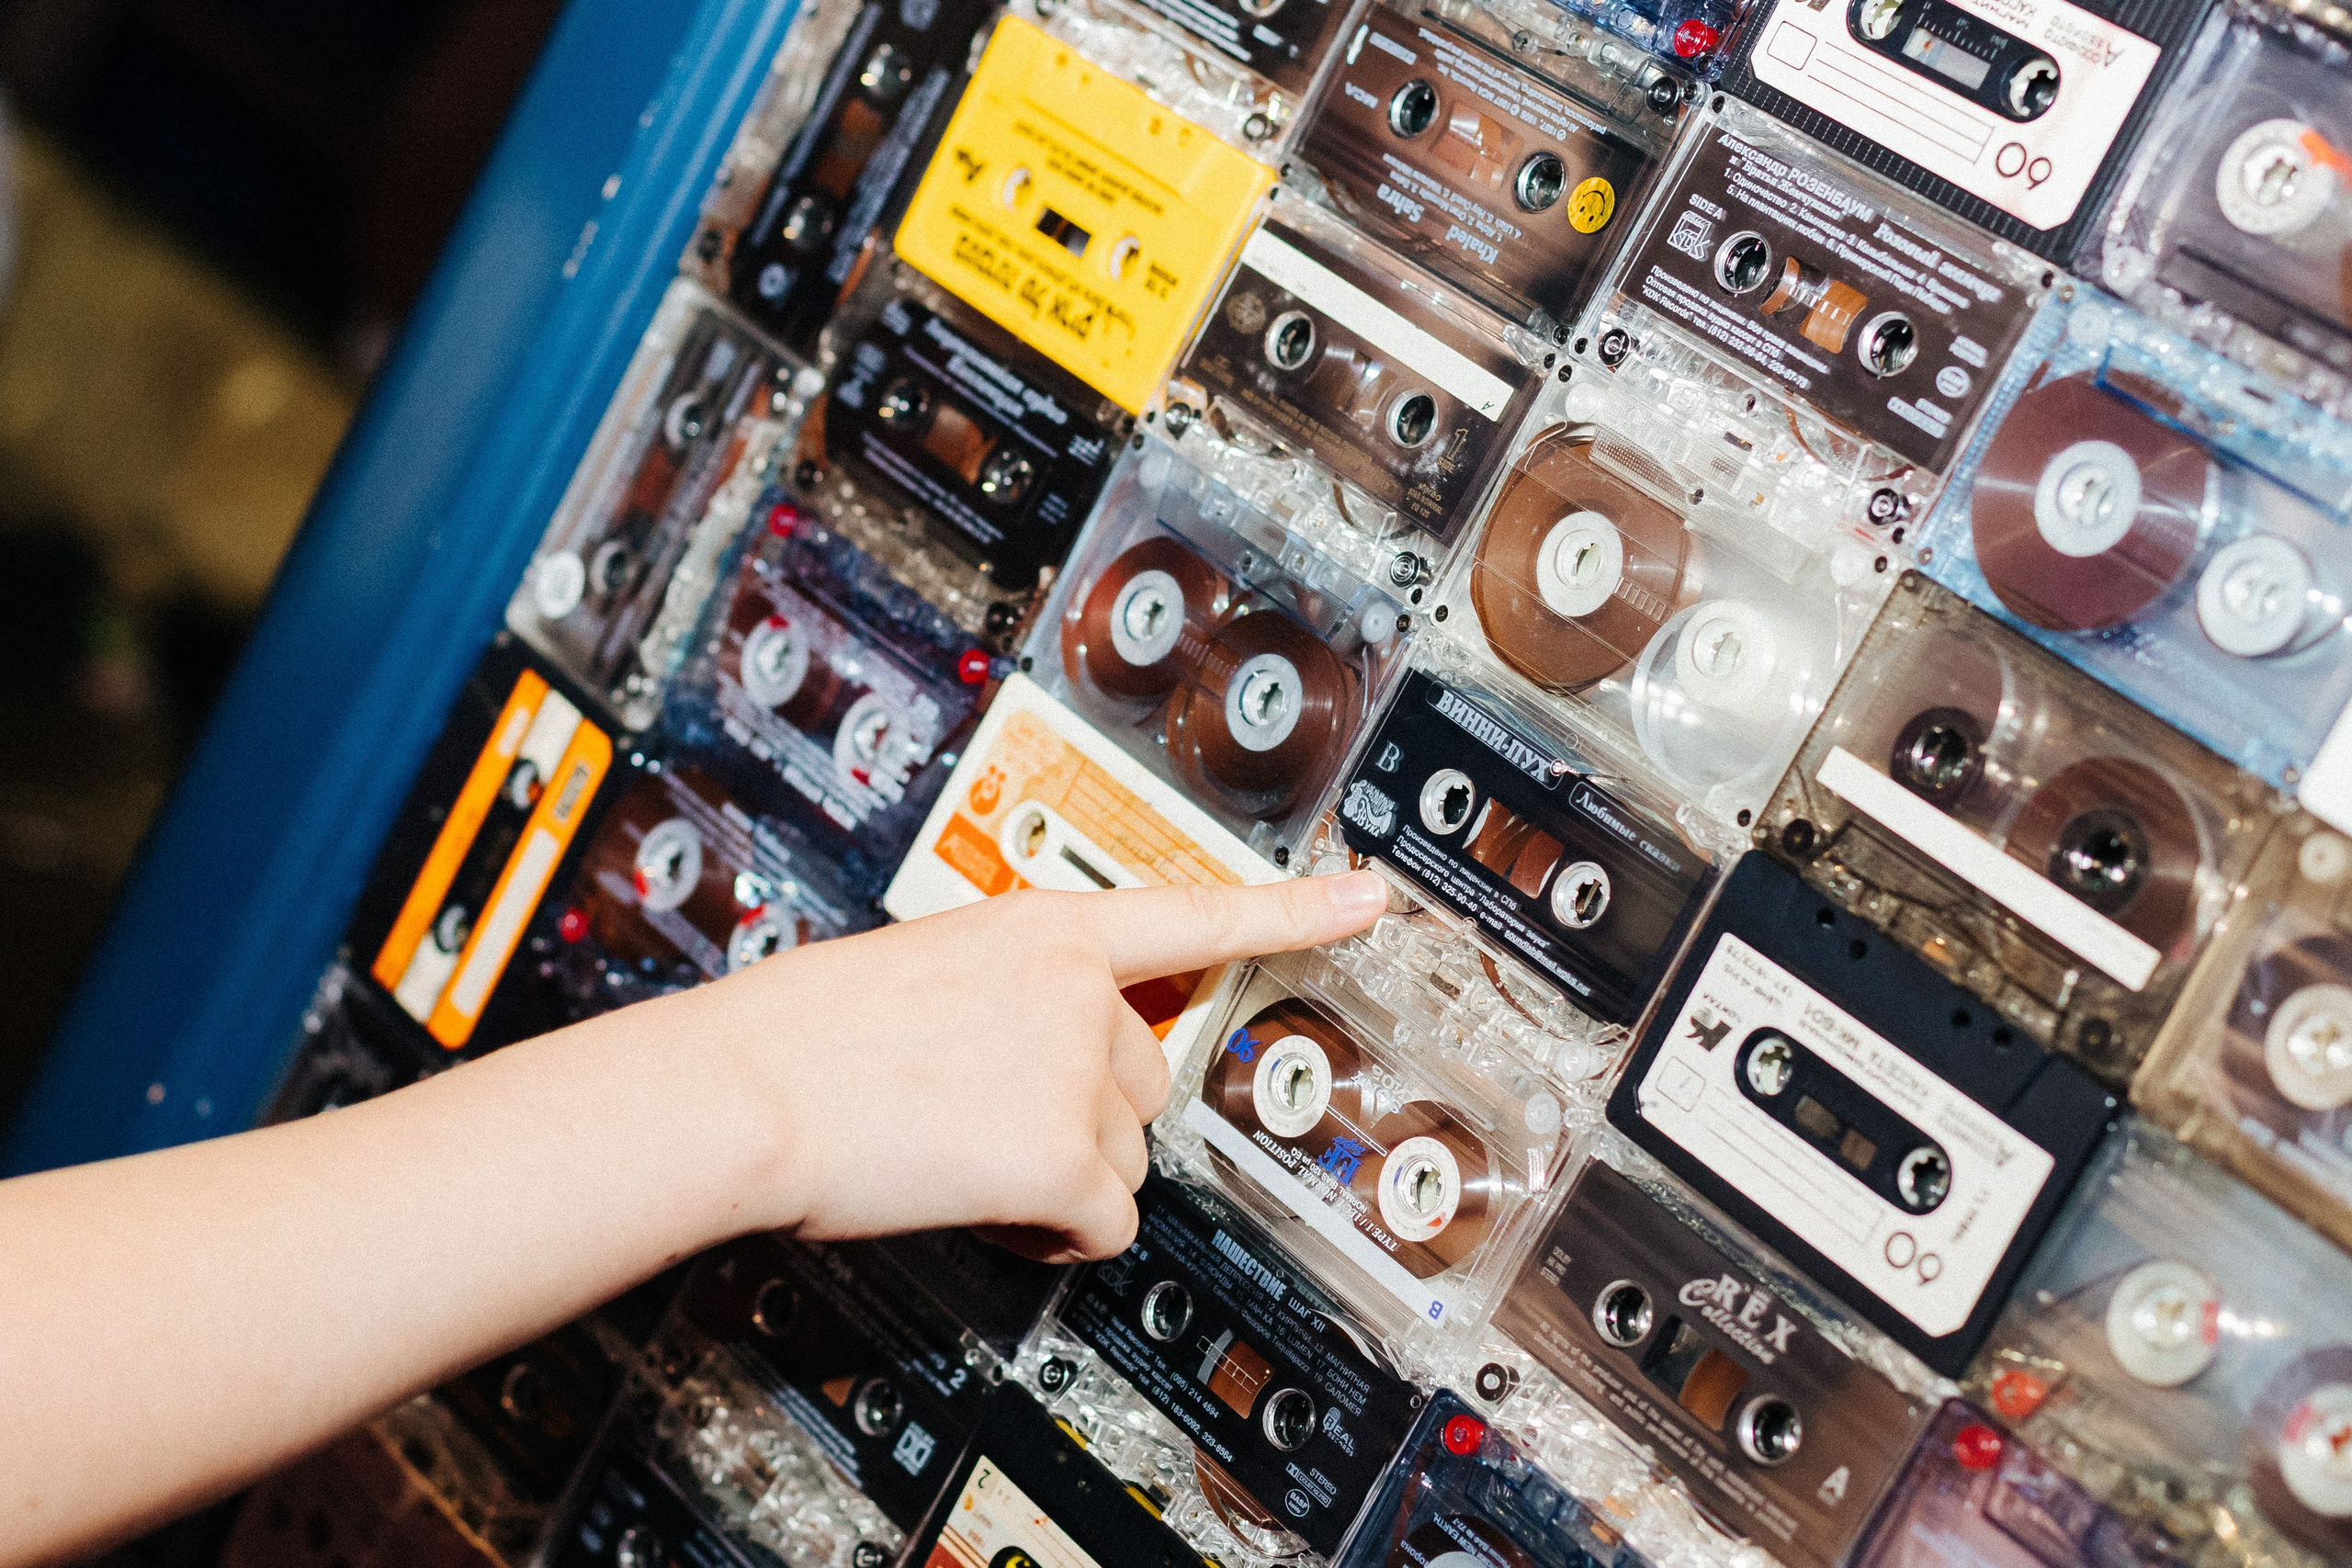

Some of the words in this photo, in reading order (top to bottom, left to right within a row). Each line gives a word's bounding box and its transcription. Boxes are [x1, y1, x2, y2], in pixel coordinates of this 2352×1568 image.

[1715, 130, 1790, 180] Александр
[1785, 164, 1874, 224] РОЗЕНБАУМ
[1993, 139, 2052, 192] 60
[1371, 181, 1427, 225] Sahra
[1687, 191, 1716, 215] SIDE
[1711, 205, 1725, 220] A
[1730, 170, 1789, 210] Одиночество
[1796, 206, 1848, 242] Камикадзе
[1735, 187, 1751, 203] На
[1746, 194, 1799, 231] плантациях
[1794, 220, 1827, 245] любви
[1443, 223, 1500, 266] Khaled
[1644, 273, 1678, 299] Оптовая
[1648, 264, 1701, 300] Произведено
[1441, 423, 1470, 462] 1
[1434, 455, 1457, 474] SIDE
[1415, 480, 1443, 502] stereo
[1431, 688, 1555, 784] ВИННИ-ПУХ
[1574, 788, 1642, 843] Любимые
[1388, 844, 1423, 873] Телефон
[1419, 867, 1442, 887] (812)
[1439, 881, 1479, 913] 325-90-40
[1393, 834, 1452, 879] Продюсерского
[1448, 874, 1476, 897] центра
[1400, 823, 1450, 862] Произведено
[1446, 856, 1460, 869] по
[1457, 864, 1494, 894] лицензии
[1498, 893, 1519, 911] СПб
[1224, 1026, 1260, 1063] 90
[1250, 1128, 1297, 1169] POSITION
[1288, 1145, 1304, 1160] EQ
[1329, 1126, 1367, 1161] Super
[1307, 1161, 1324, 1177] 120
[1312, 1136, 1367, 1189] EF
[1318, 1170, 1340, 1190] BIAS
[1294, 1163, 1339, 1202] NORMAL
[1337, 1186, 1369, 1214] NORMAL
[1340, 1201, 1363, 1223] IEC
[1370, 1225, 1399, 1252] TYPE
[1884, 1231, 1944, 1285] 60
[1207, 1228, 1289, 1302] НАШЕСТВИЕ
[1285, 1296, 1312, 1321] ШАГ
[1309, 1315, 1328, 1334] XII
[1423, 1298, 1446, 1321] B
[1275, 1309, 1313, 1344] КИРПИЧИ
[1323, 1351, 1371, 1393] МАГНИТНАЯ
[1284, 1333, 1314, 1359] LUMEN
[1324, 1368, 1350, 1391] БОНИ
[1346, 1386, 1367, 1406] НЕМ
[944, 1365, 972, 1393] 2
[1148, 1369, 1174, 1393] кассет
[1168, 1371, 1190, 1392] (095)
[1186, 1388, 1203, 1404] 214
[1200, 1400, 1220, 1419] 4594
[1107, 1344, 1139, 1374] Records"
[1148, 1384, 1171, 1405] (812)
[1199, 1430, 1235, 1463] 323-8564
[1322, 1381, 1363, 1417] САЛОМЕЯ
[972, 1467, 994, 1490] 2
[1306, 1466, 1339, 1496] STEREO
[1821, 1461, 1858, 1499] A
[1287, 1490, 1309, 1511] BASF
[1429, 1510, 1461, 1540] EARTH.
[1456, 1534, 1478, 1555] NEW
